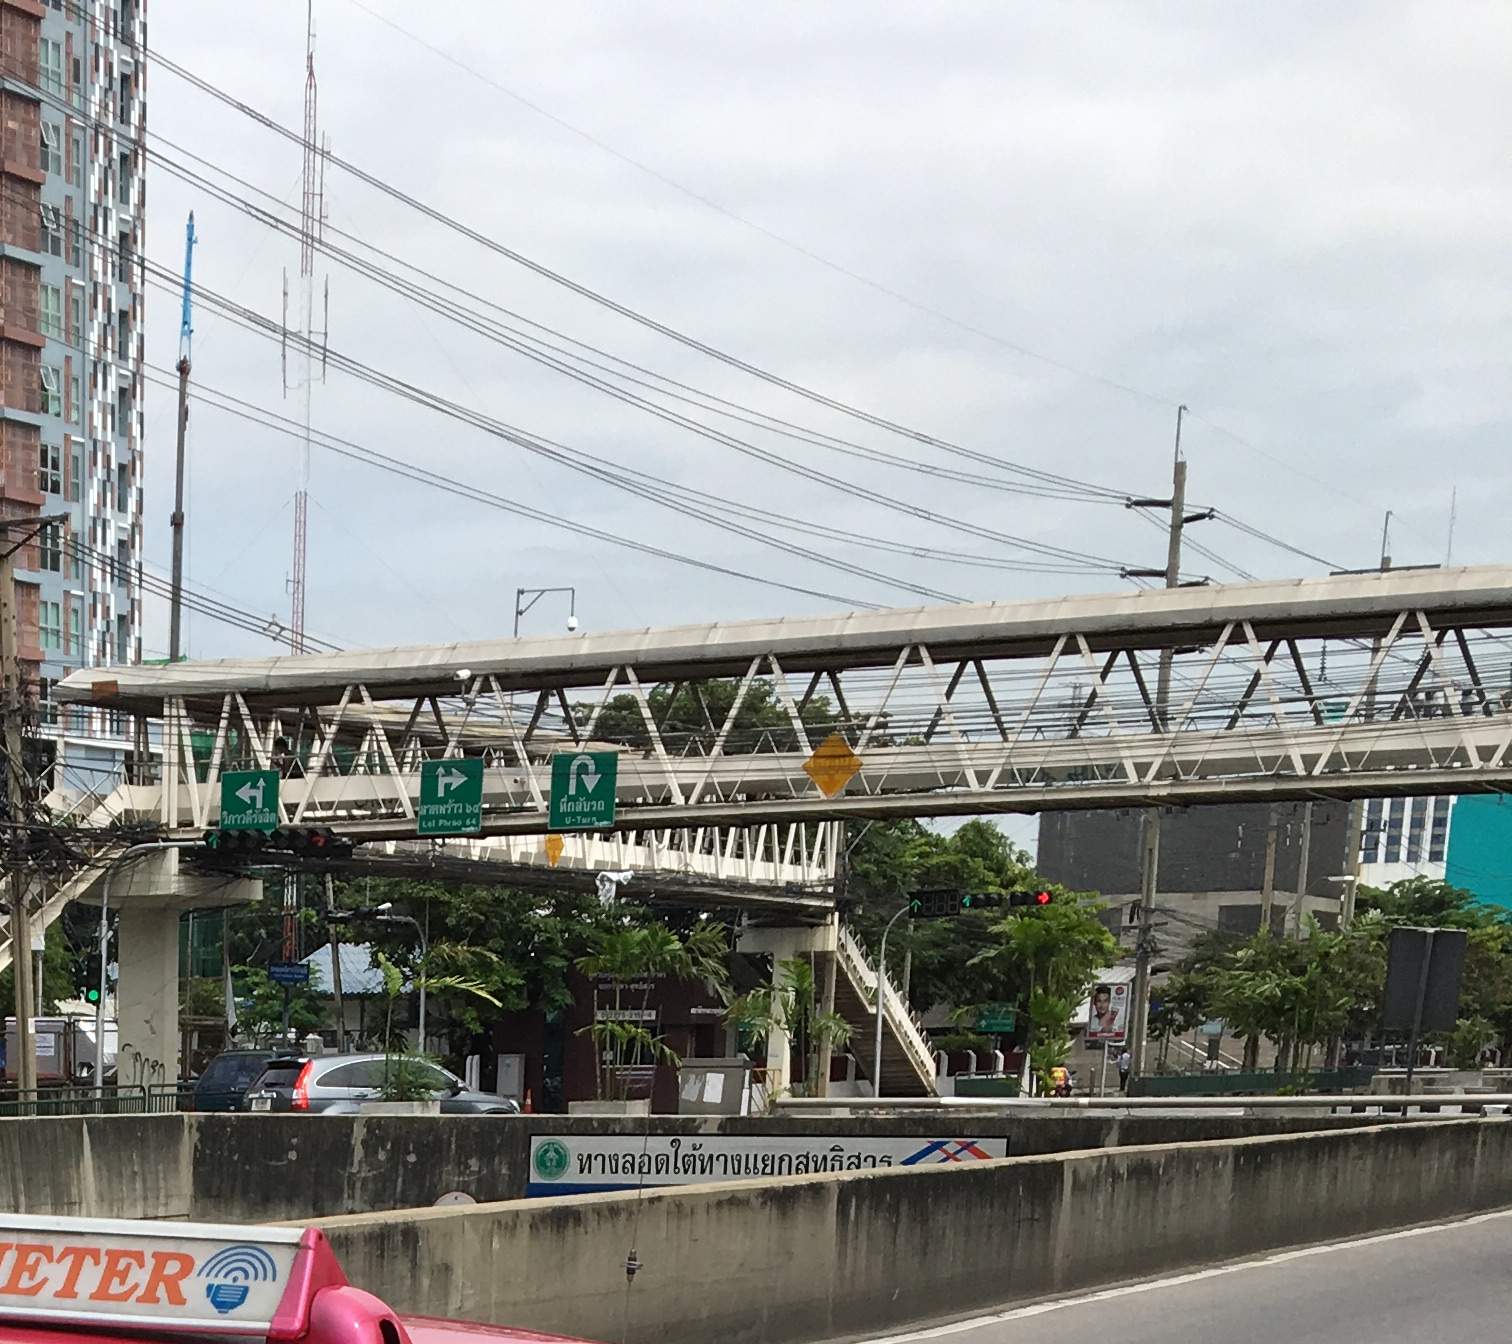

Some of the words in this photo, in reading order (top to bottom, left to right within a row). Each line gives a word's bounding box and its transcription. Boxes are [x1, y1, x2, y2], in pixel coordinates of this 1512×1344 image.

[559, 795, 605, 813] ที่กลับรถ
[576, 1138, 893, 1176] ทางลอดใต้ทางแยกสทธิสาร
